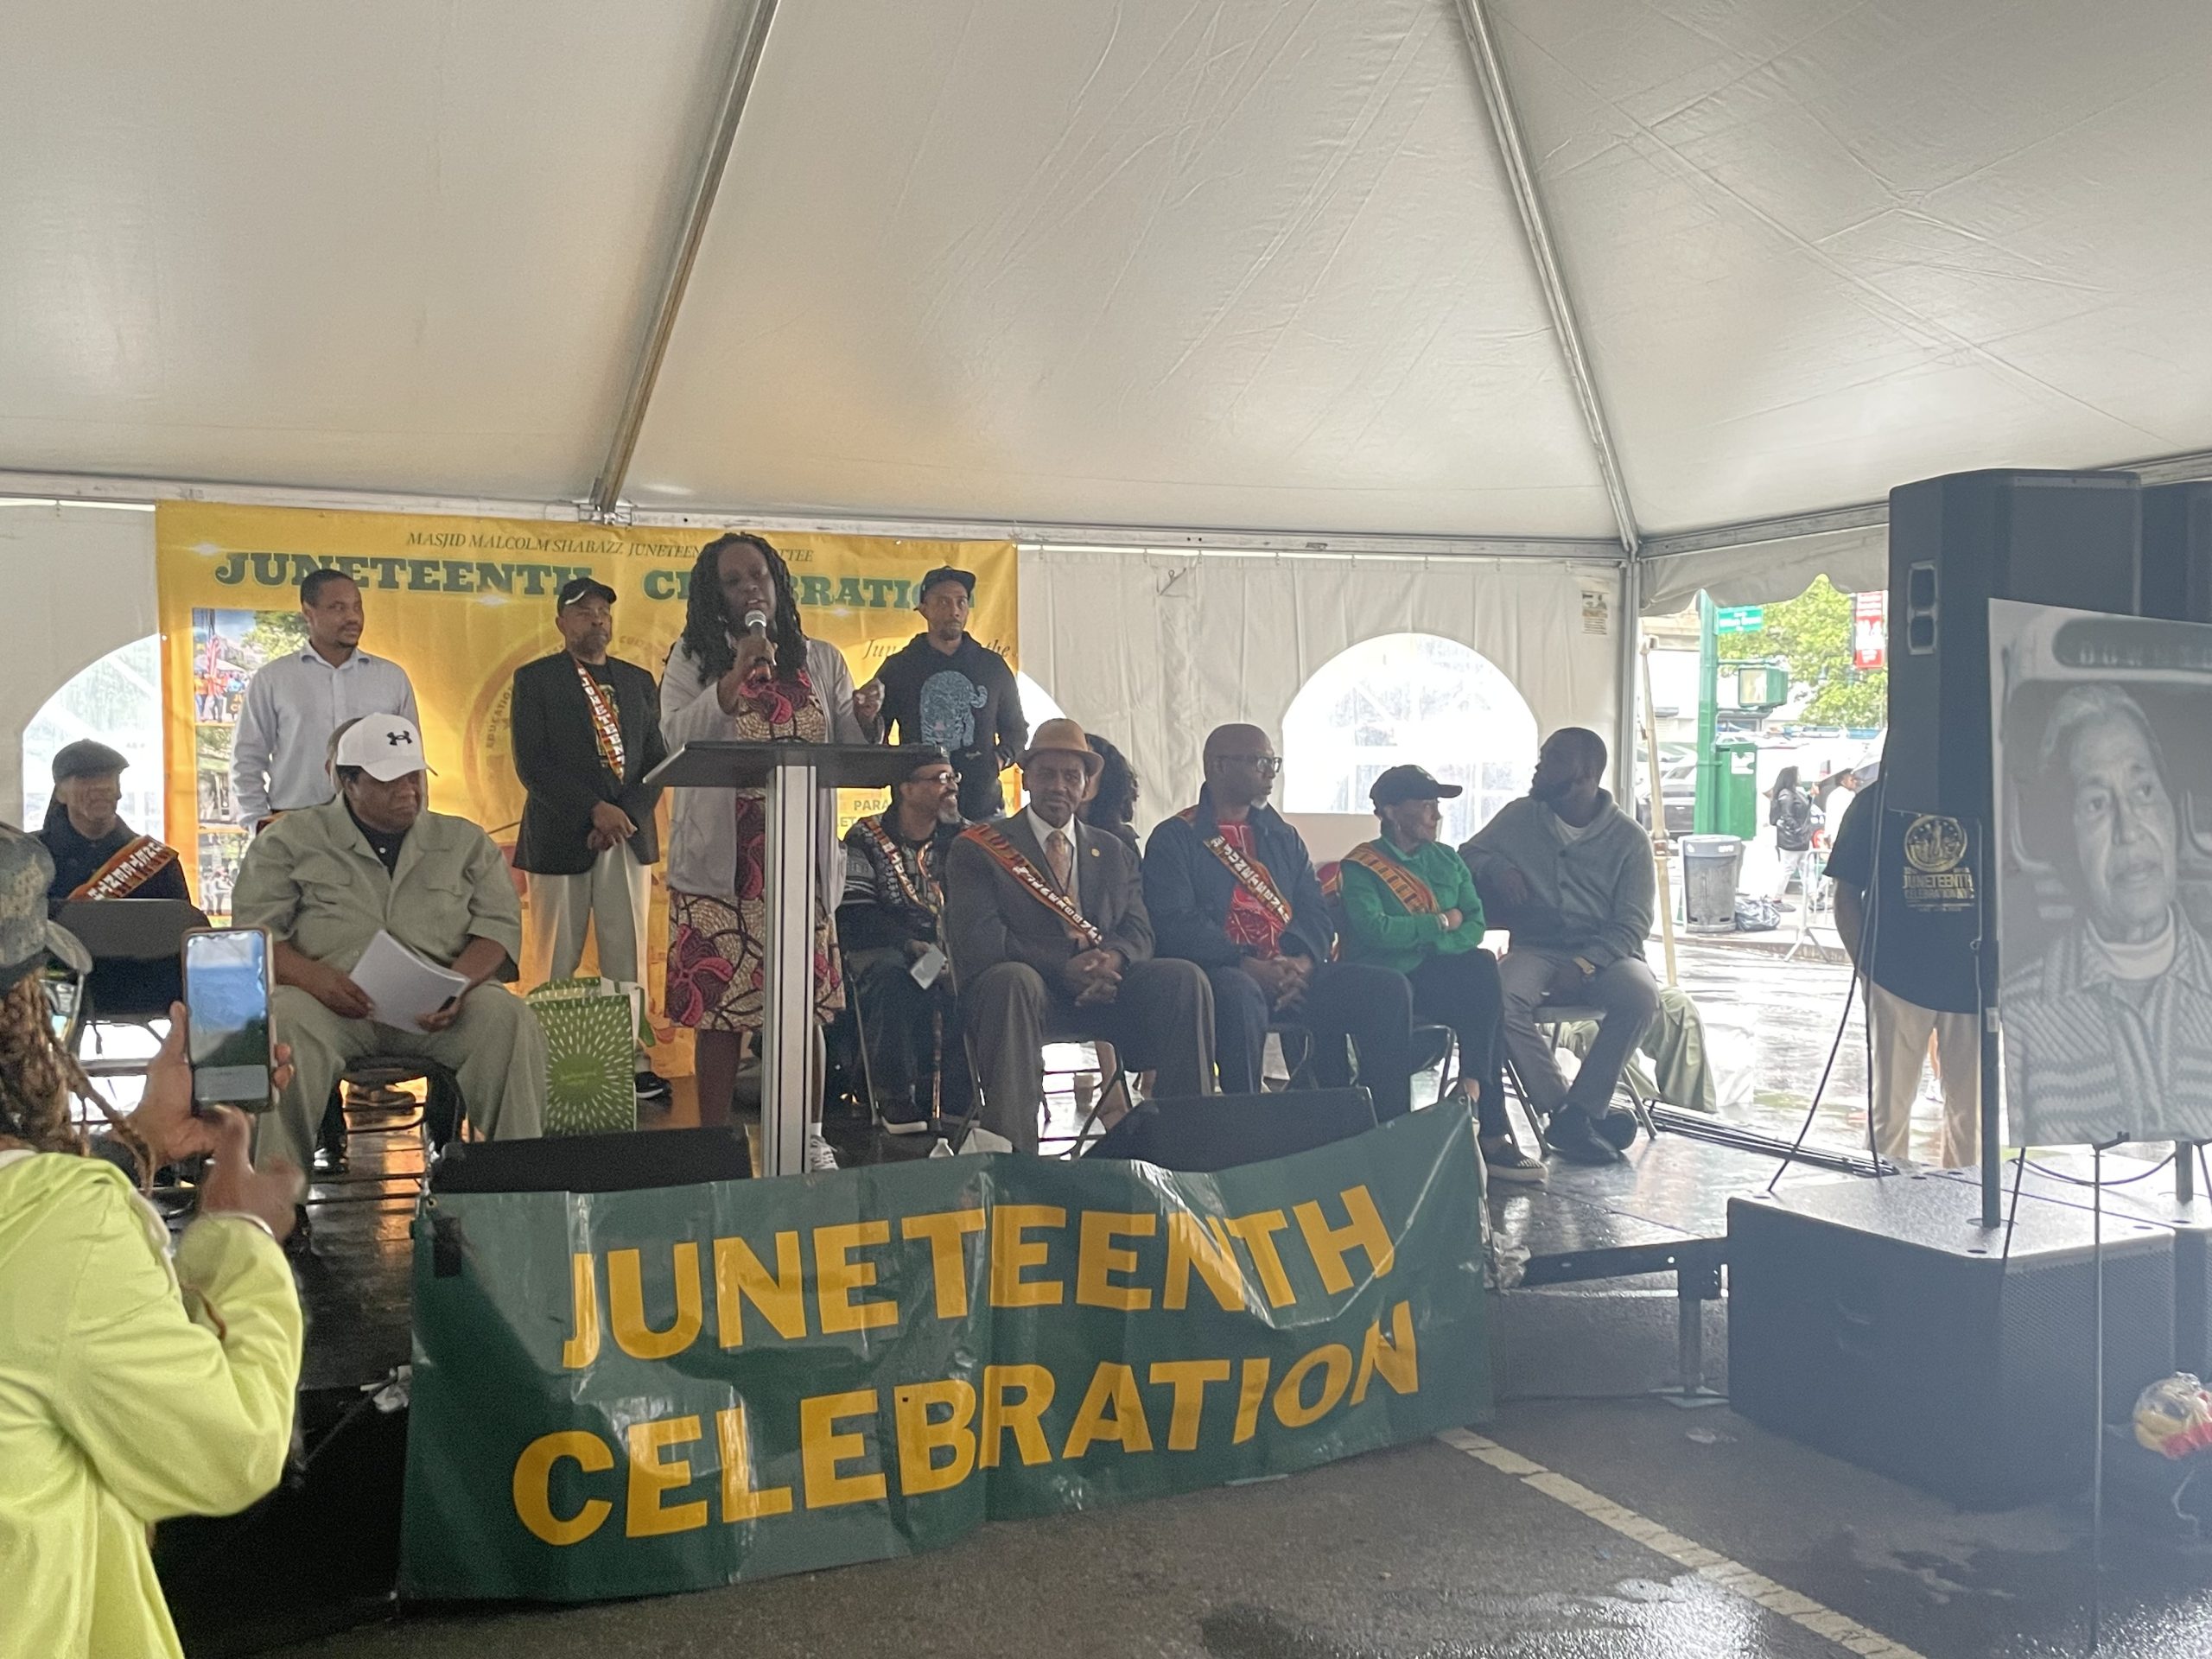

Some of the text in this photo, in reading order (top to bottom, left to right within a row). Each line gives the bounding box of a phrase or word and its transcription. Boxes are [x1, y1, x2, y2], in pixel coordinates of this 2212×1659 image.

[409, 532, 466, 549] MASJID
[469, 534, 550, 551] MALCOLM
[551, 537, 624, 555] SHABAZZ
[563, 1185, 1394, 1369] JUNETEENTH
[513, 1300, 1419, 1546] CELEBRATION
